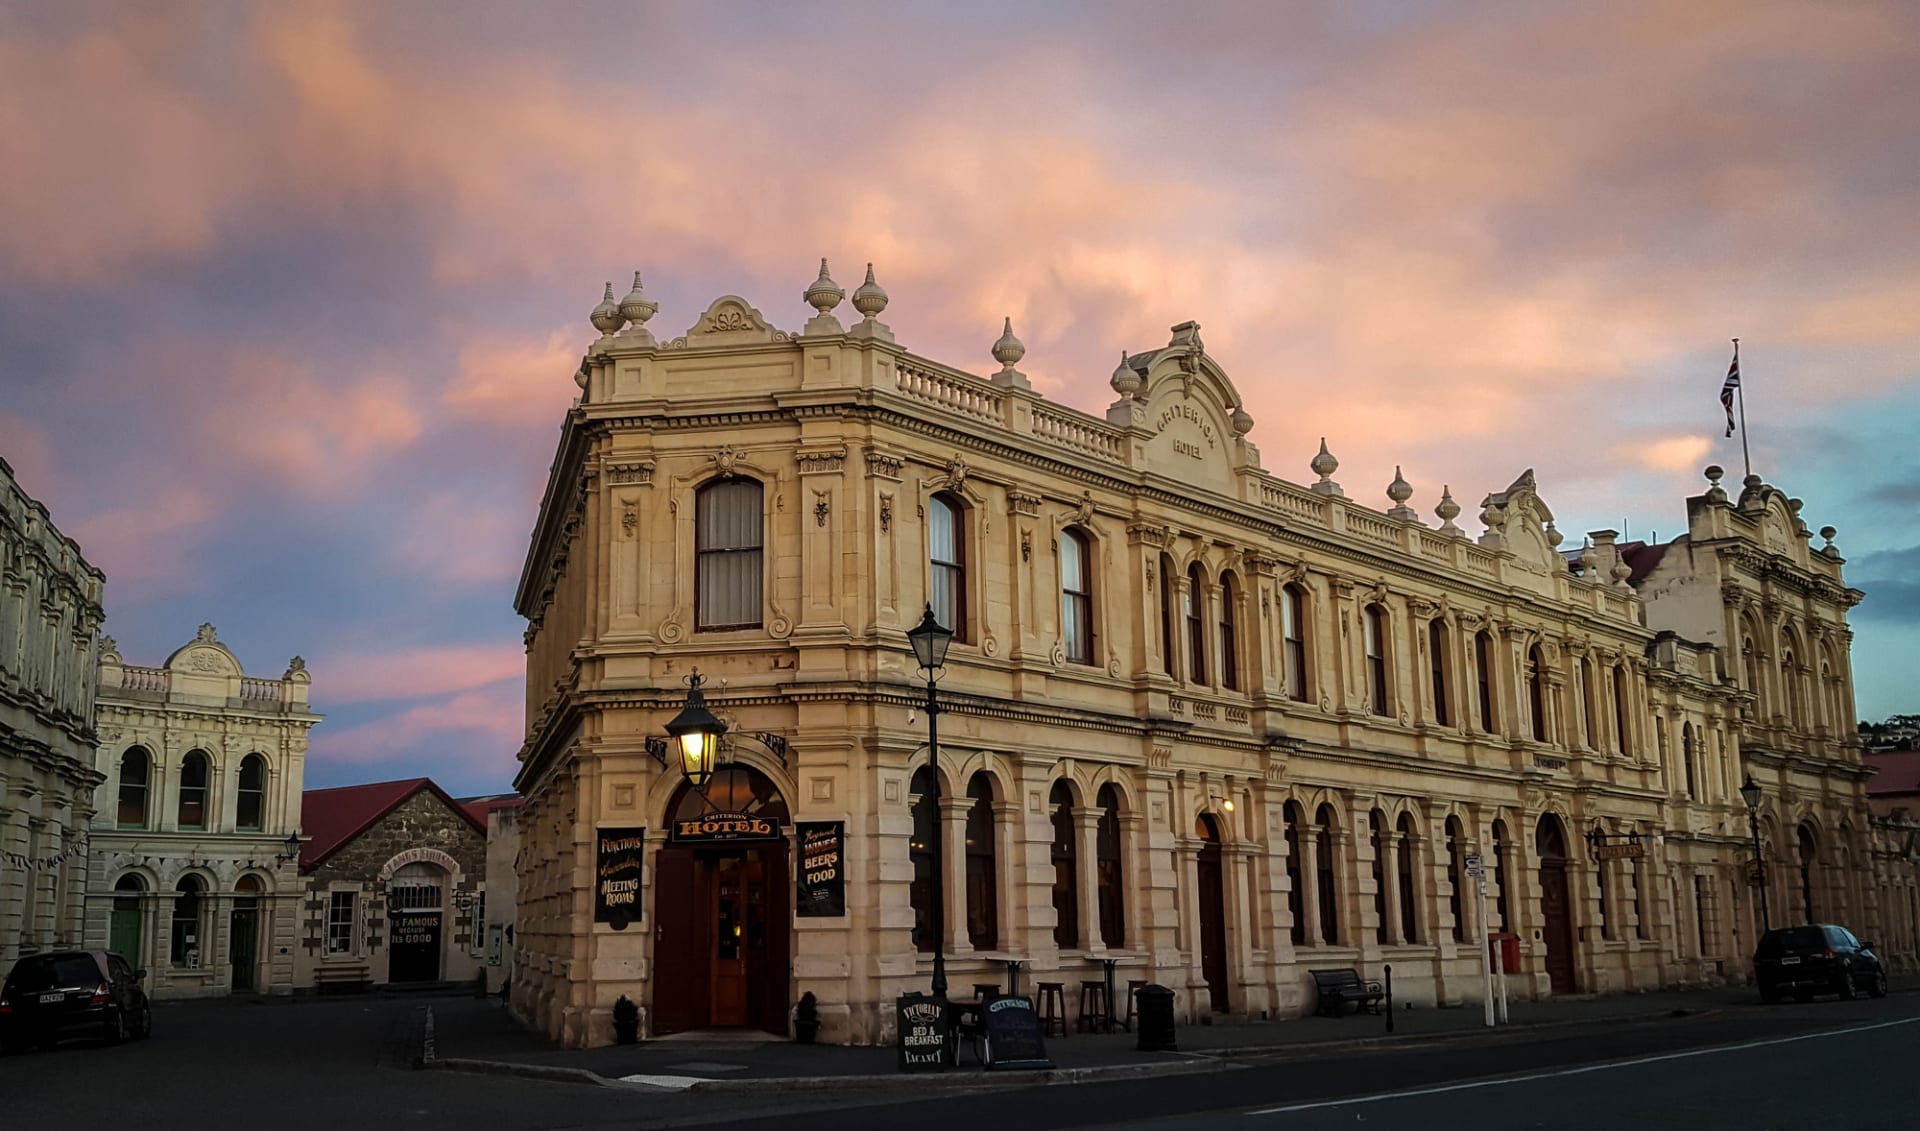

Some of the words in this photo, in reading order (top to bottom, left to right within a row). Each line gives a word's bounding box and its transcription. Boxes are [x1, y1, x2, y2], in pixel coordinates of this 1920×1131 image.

[704, 813, 747, 821] CRITERION
[679, 819, 771, 835] HOTEL
[804, 852, 838, 869] BEERS
[807, 869, 836, 885] FOOD
[601, 878, 639, 895] MEETING
[606, 892, 635, 907] ROOMS
[402, 917, 438, 927] FAMOUS
[405, 934, 432, 943] GOOD
[913, 1027, 927, 1036] BED
[929, 1026, 935, 1036] &
[904, 1035, 944, 1046] BREAKFAST
[905, 1049, 942, 1064] VACANCY
